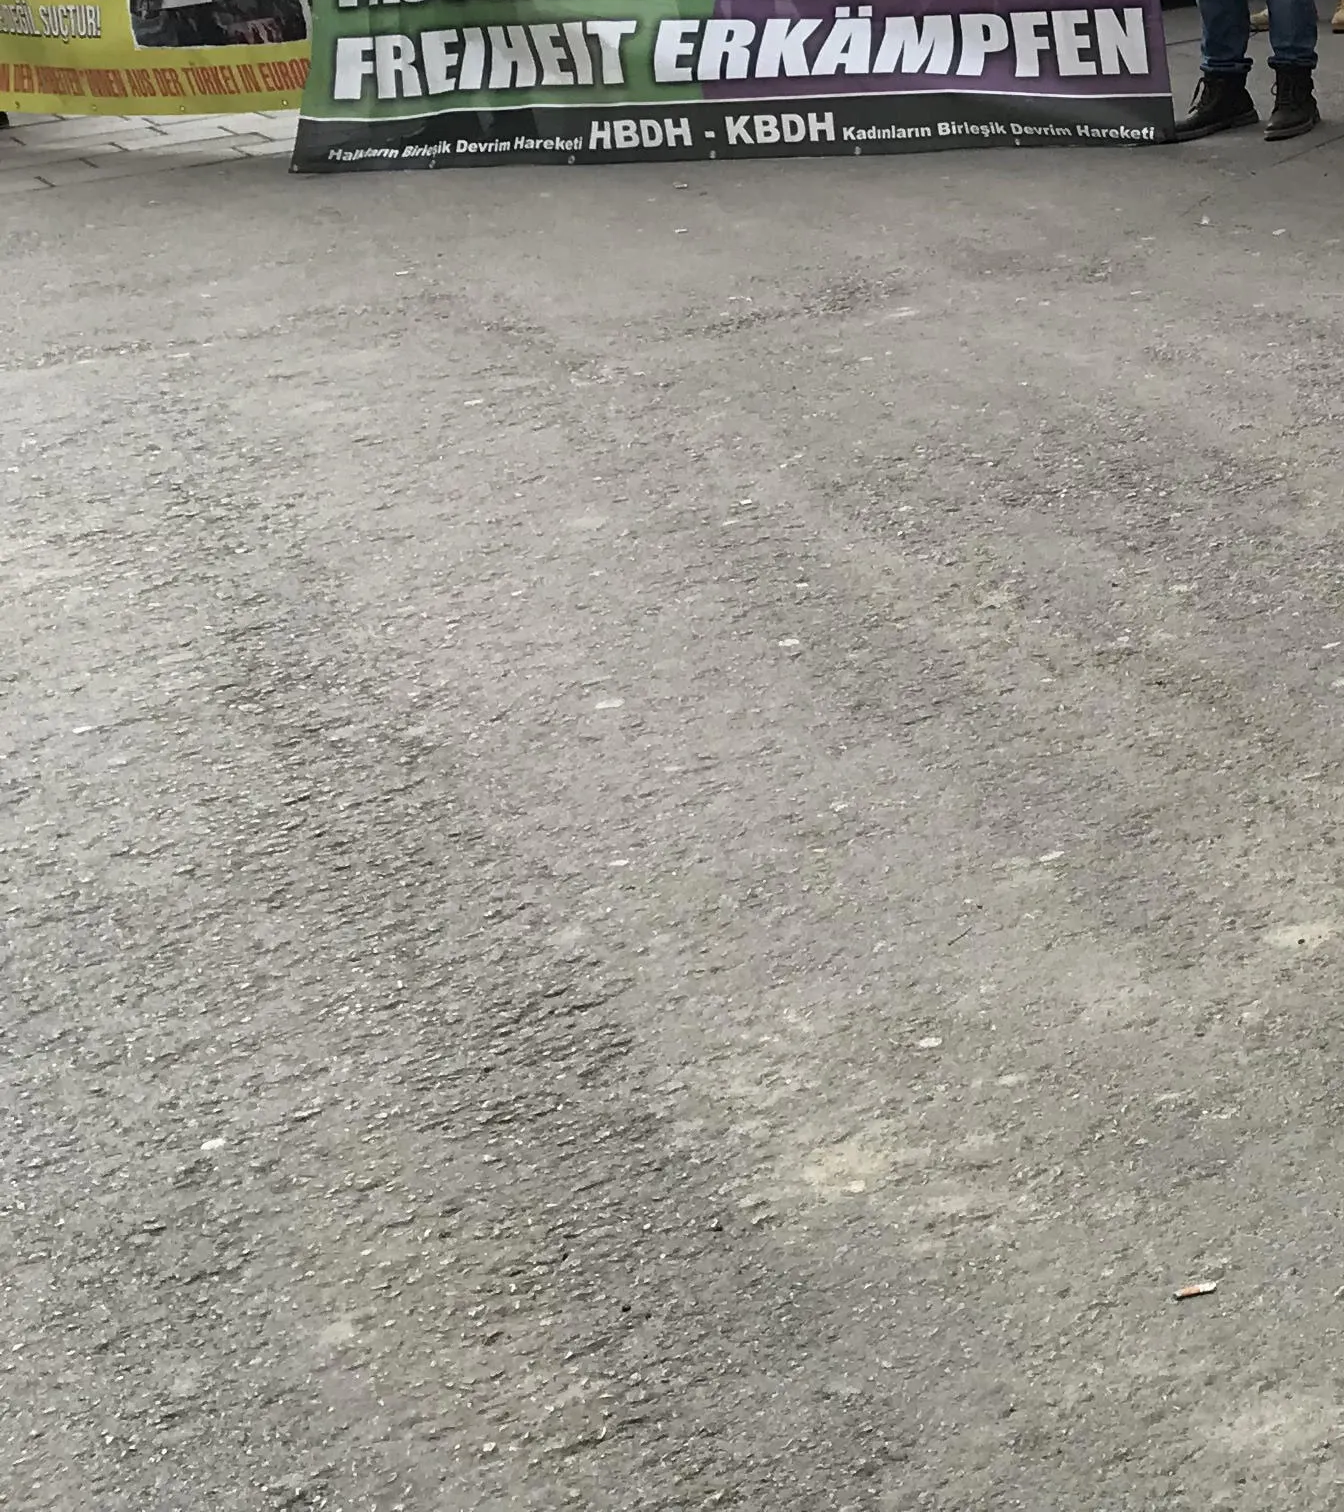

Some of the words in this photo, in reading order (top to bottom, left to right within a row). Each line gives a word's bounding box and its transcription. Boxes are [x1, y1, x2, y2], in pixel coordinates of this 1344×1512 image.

[38, 4, 101, 44] SUÇTUR!
[333, 19, 637, 100] FREIHEIT
[654, 6, 1150, 83] ERKÄMPFEN
[125, 66, 158, 98] AUS
[152, 66, 186, 97] DER
[181, 61, 240, 96] TÜRKEI
[236, 63, 259, 94] IN
[257, 58, 311, 92] EUROP
[455, 138, 511, 154] Devrim
[513, 136, 583, 151] Hareketi
[589, 117, 693, 150] HBDH
[726, 111, 836, 146] KBDH
[842, 122, 933, 142] Kadınların
[936, 120, 1007, 140] Birleşik
[1010, 121, 1072, 138] Devrim
[1076, 124, 1155, 142] Hareketi
